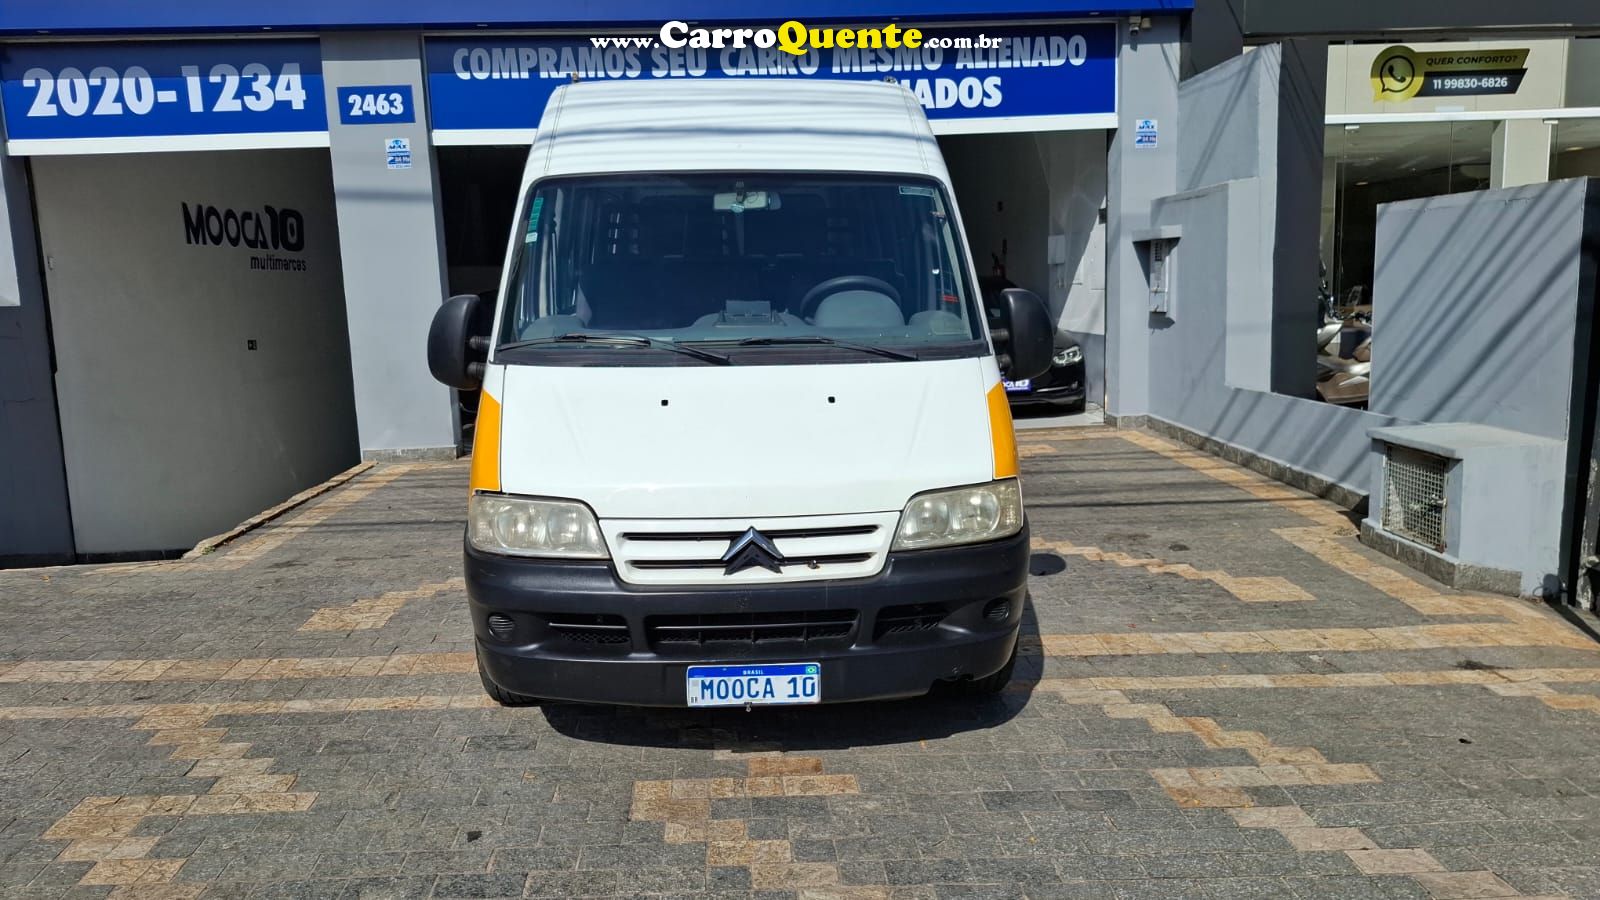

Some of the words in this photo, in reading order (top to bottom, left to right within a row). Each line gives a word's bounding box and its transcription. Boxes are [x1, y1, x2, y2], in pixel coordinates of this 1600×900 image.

[453, 46, 642, 80] COMPRAMOS
[651, 46, 708, 78] SEU
[719, 45, 820, 76] CARRO
[832, 44, 944, 74] MESMO
[955, 35, 1088, 70] ALIENADO
[1425, 57, 1455, 66] QUER
[1456, 55, 1518, 66] CONFORTO?
[22, 62, 307, 117] 2020-1234
[1433, 79, 1442, 90] 11
[1444, 77, 1508, 89] 99830-6826
[348, 93, 404, 116] 2463
[250, 254, 307, 271] multimarcas
[700, 678, 775, 700] MOOCA
[787, 677, 816, 698] 10
